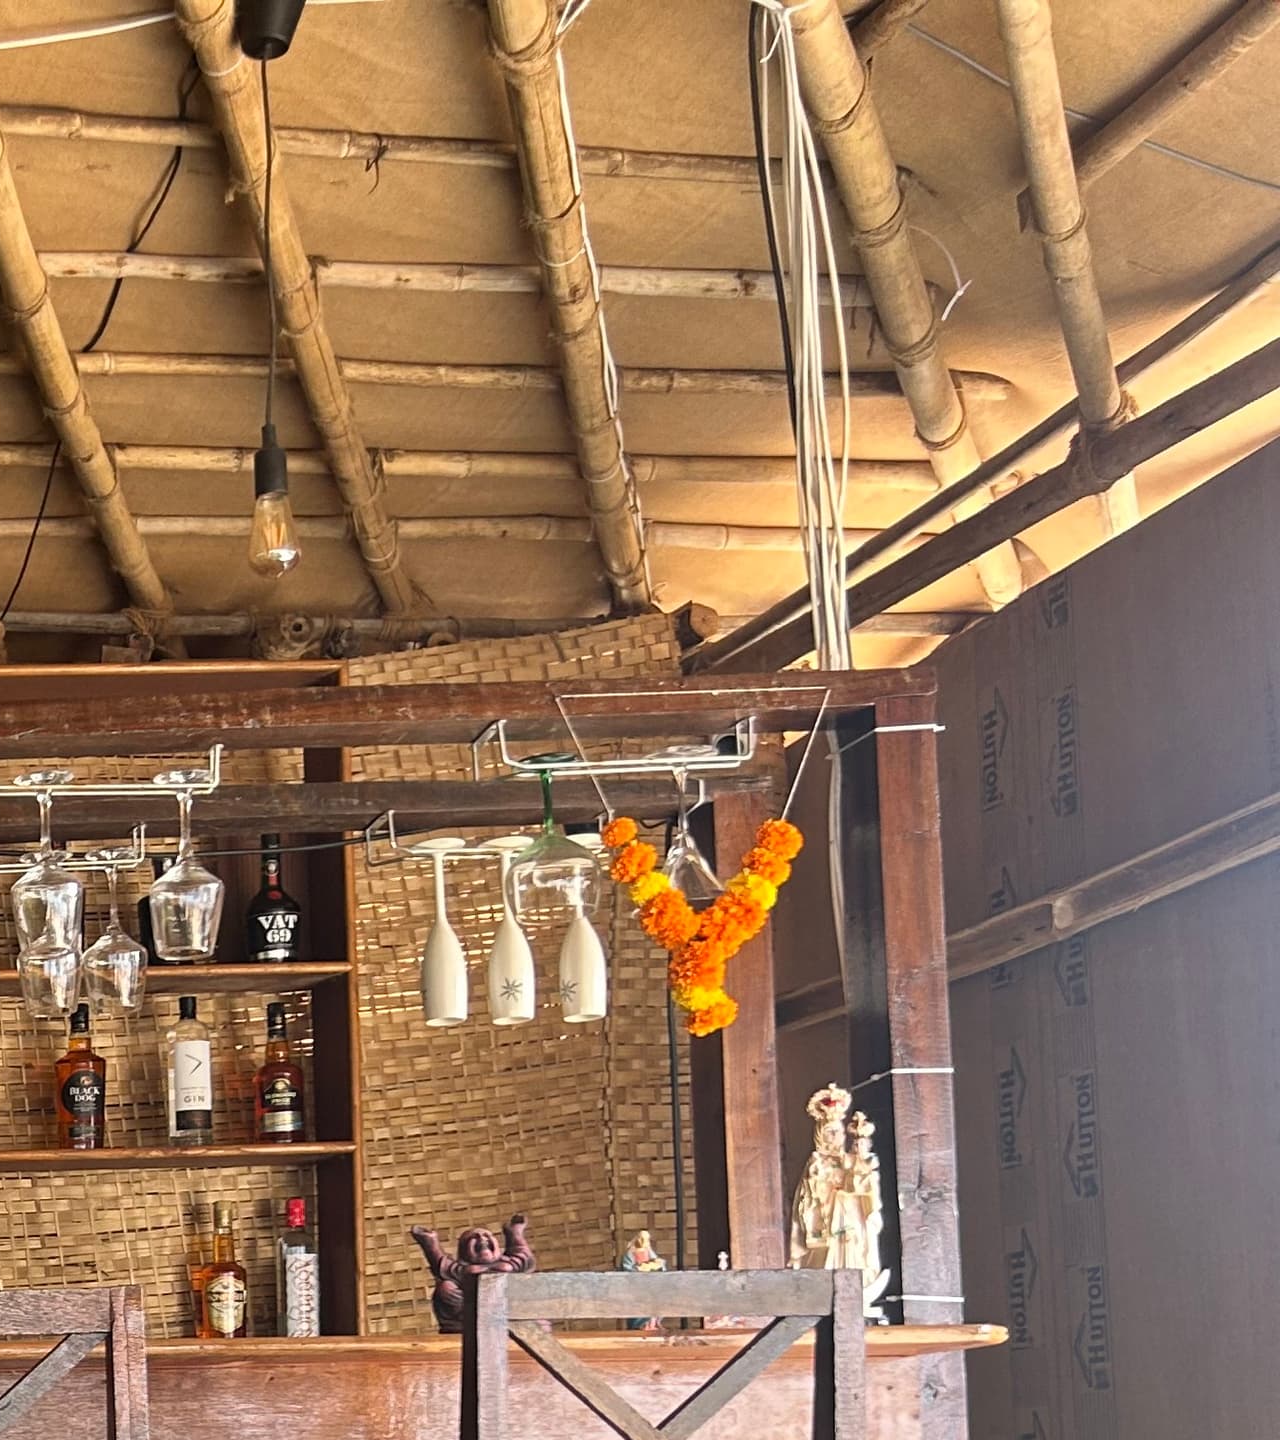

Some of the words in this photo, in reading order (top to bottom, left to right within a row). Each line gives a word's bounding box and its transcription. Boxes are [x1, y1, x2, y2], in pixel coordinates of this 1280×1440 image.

[257, 914, 298, 930] VAT
[266, 930, 292, 943] 69
[69, 1087, 100, 1095] BLACK
[74, 1094, 97, 1102] DOG
[183, 1095, 205, 1103] GIN
